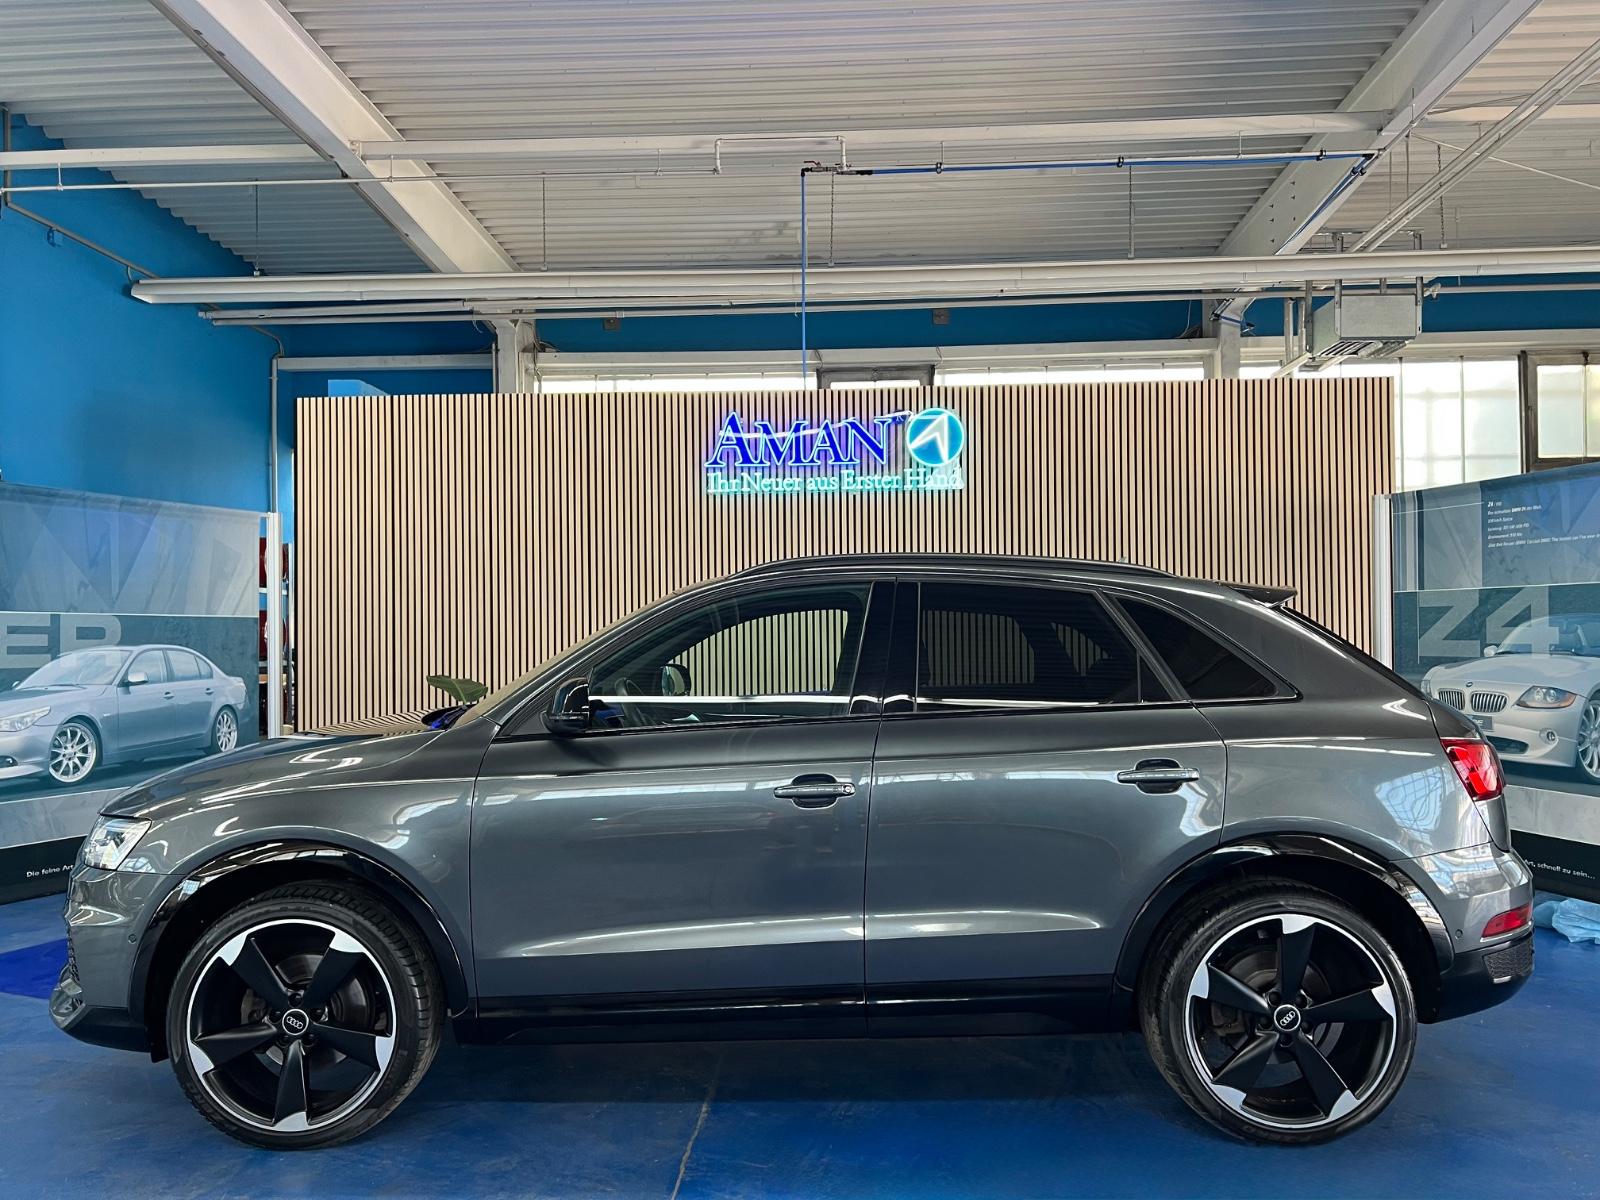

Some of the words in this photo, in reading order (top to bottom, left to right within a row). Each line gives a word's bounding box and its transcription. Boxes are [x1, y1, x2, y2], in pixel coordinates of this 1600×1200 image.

[704, 411, 892, 467] AMAN
[707, 471, 739, 492] Ihr
[741, 472, 802, 492] Neuer
[806, 475, 838, 490] aus
[841, 469, 902, 491] Erster
[904, 466, 964, 490] Hand
[1419, 586, 1559, 659] Z4
[41, 867, 61, 875] feine
[1537, 862, 1561, 872] schnell
